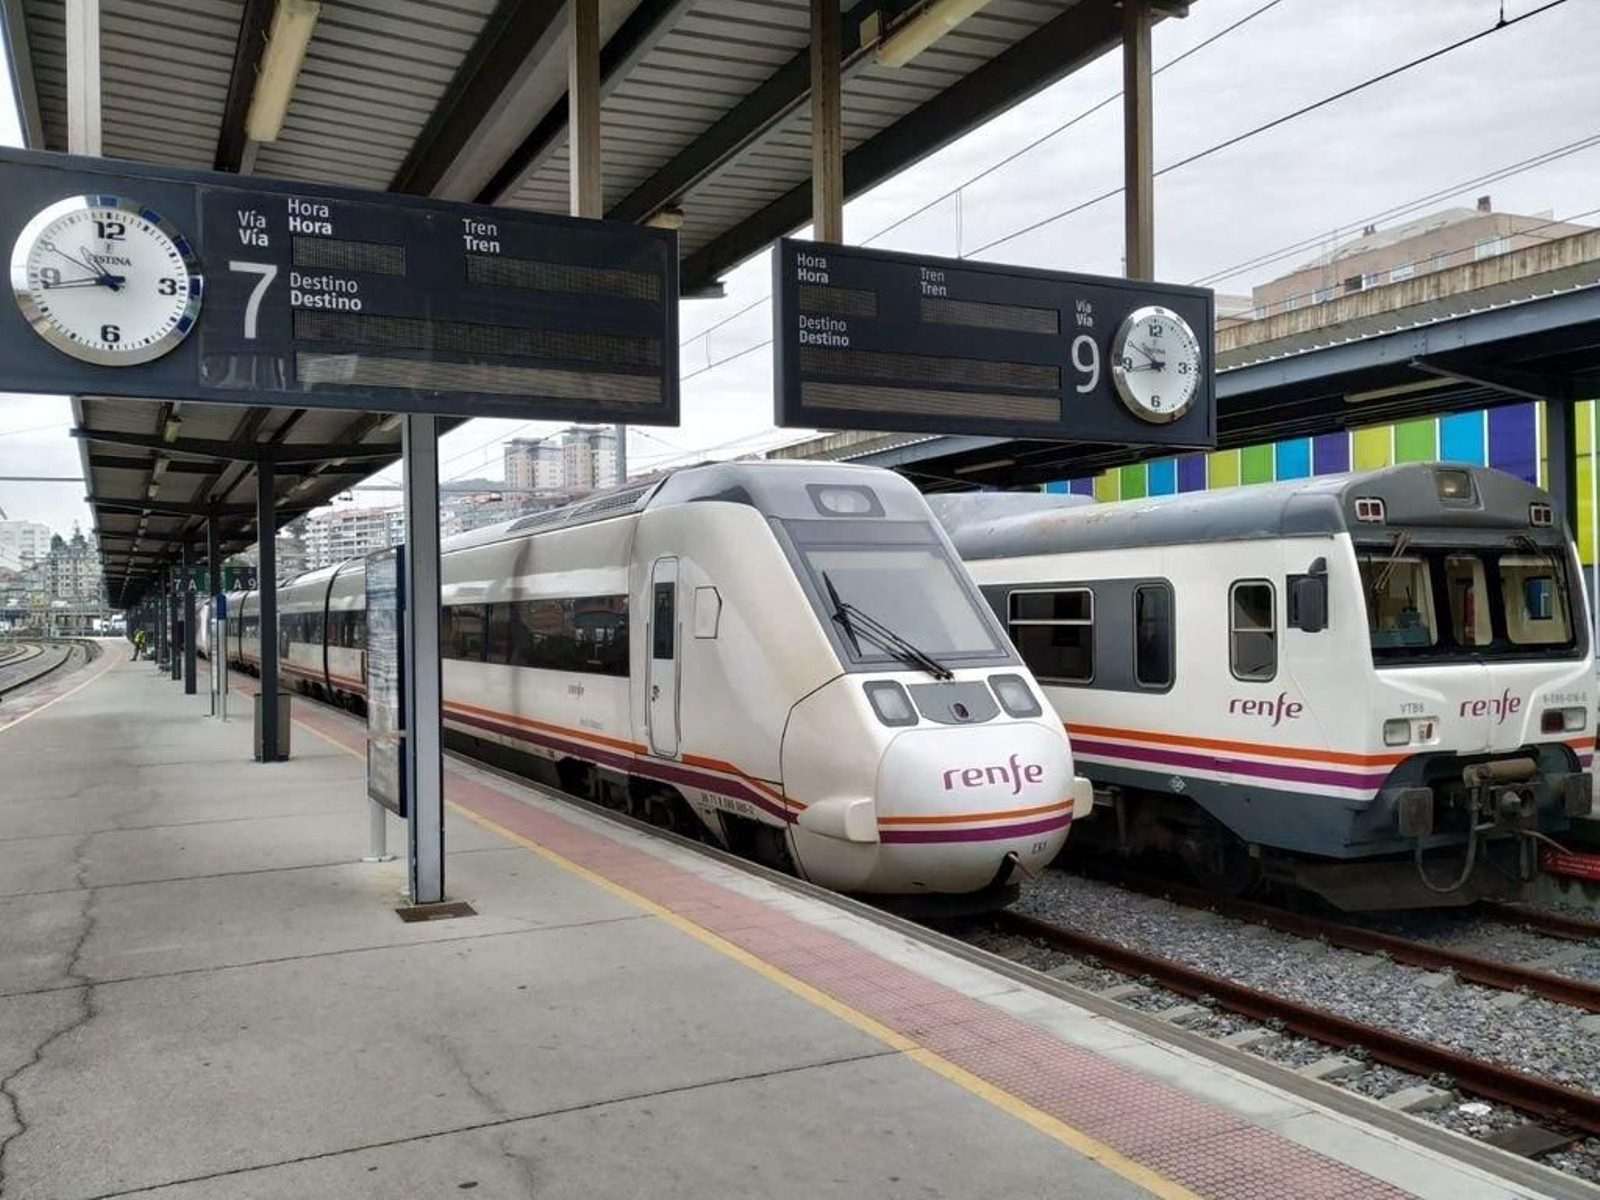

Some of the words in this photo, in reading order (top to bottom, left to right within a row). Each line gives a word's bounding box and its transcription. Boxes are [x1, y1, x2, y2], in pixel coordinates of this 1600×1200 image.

[288, 198, 329, 217] Hora
[238, 210, 266, 228] Vía
[289, 216, 332, 235] Hora
[462, 218, 498, 236] Tren
[94, 220, 126, 241] 12
[239, 229, 269, 247] Vía
[463, 235, 501, 253] Tren
[797, 253, 827, 268] Hora
[290, 272, 358, 293] Destino
[798, 268, 829, 284] Hora
[920, 267, 945, 282] Tren
[158, 278, 177, 296] 3
[921, 282, 948, 297] Tren
[229, 261, 277, 339] 7
[291, 290, 362, 311] Destino
[799, 315, 847, 332] Destino
[1148, 324, 1163, 338] 12
[100, 325, 121, 343] 6
[799, 330, 849, 347] Destino
[1071, 335, 1100, 393] 9
[1178, 362, 1188, 375] 3
[1151, 395, 1161, 408] 6
[174, 579, 182, 591] 7
[188, 579, 198, 591] A
[233, 578, 243, 591] A
[247, 577, 257, 590] 9
[1229, 692, 1304, 727] renfe
[1460, 688, 1521, 725] renfe
[943, 754, 1043, 796] renfe
